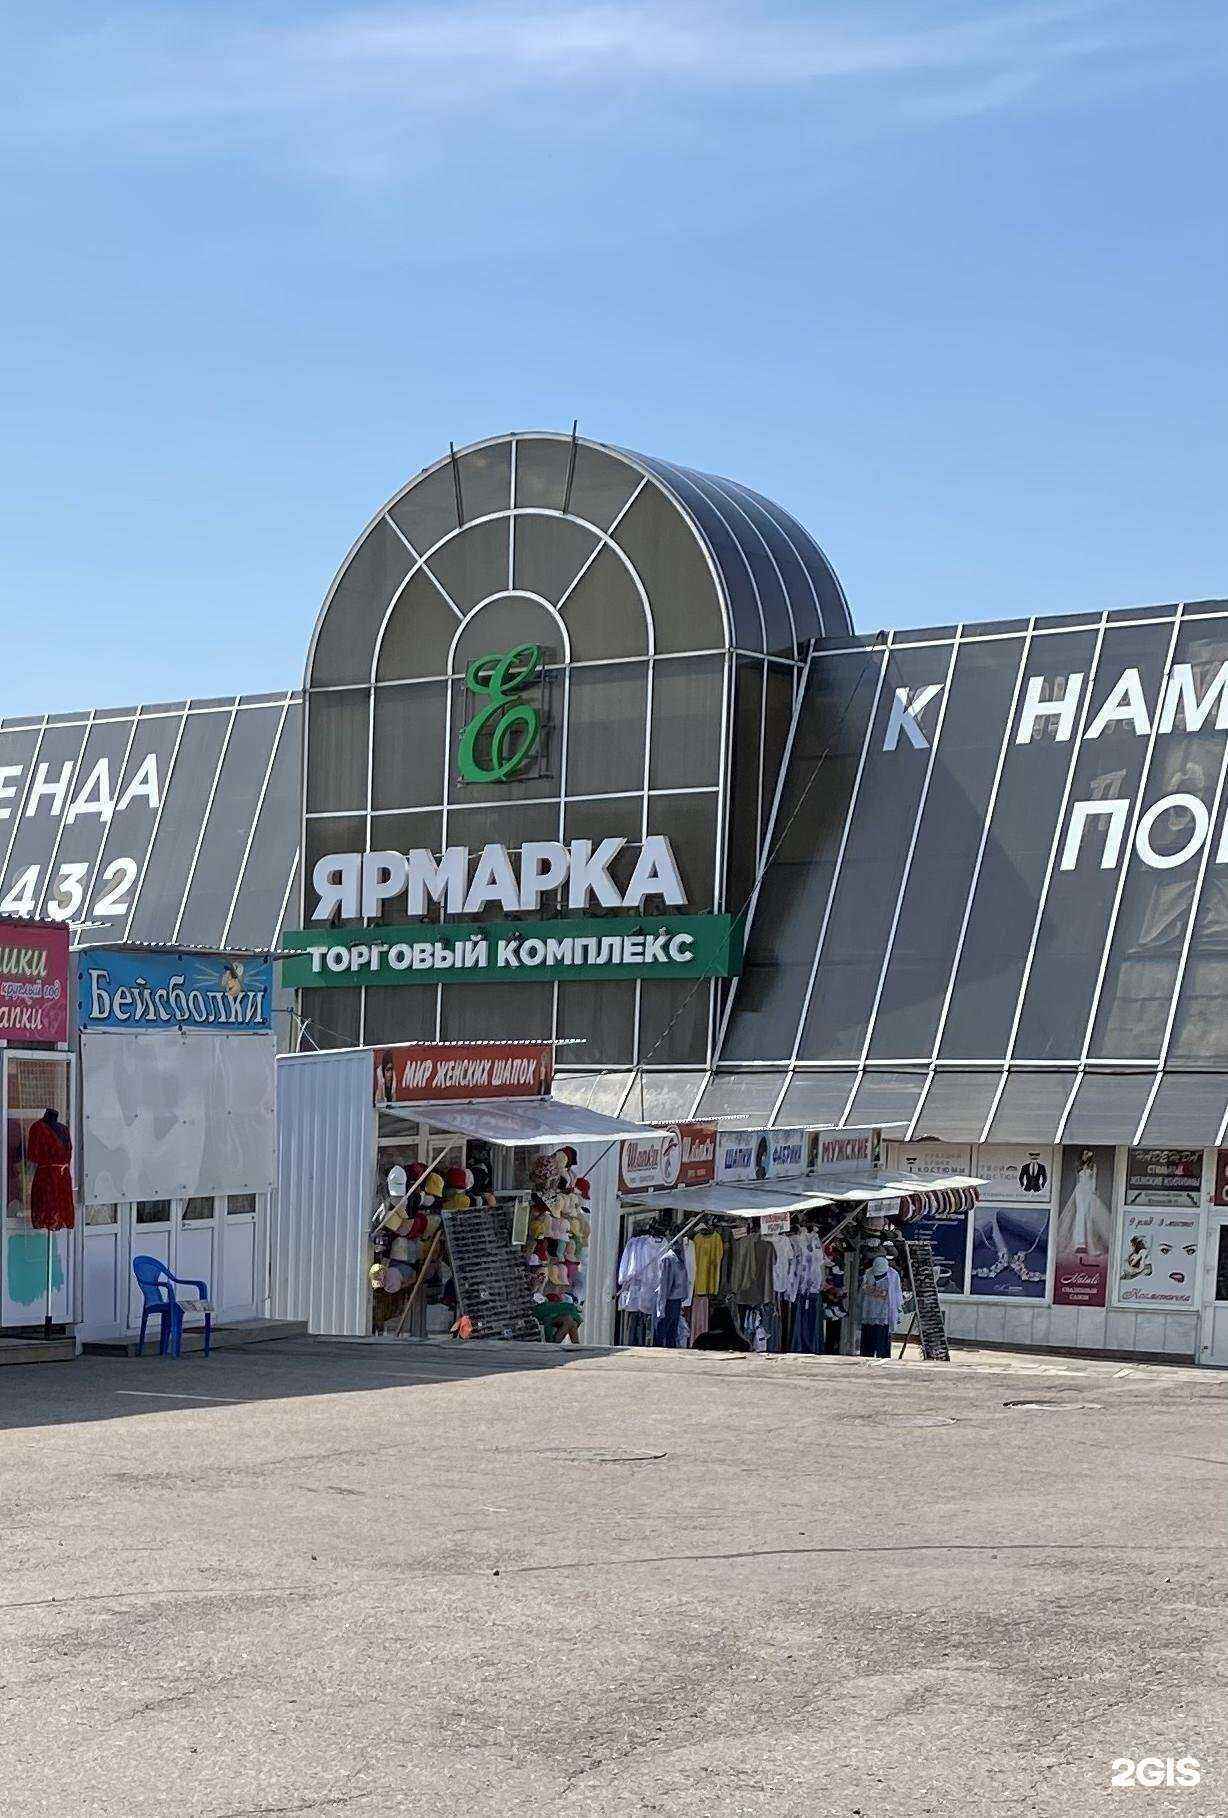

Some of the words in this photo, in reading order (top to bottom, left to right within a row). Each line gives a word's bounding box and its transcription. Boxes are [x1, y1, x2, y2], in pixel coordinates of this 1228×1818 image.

[883, 684, 945, 751] К
[1015, 660, 1228, 745] НАМ
[0, 857, 138, 921] 432
[311, 835, 688, 921] ЯРМАРКА
[0, 947, 47, 977] ики
[307, 933, 488, 972] ТОРГОВЫЙ
[497, 933, 694, 968] КОМПЛЕКС
[89, 968, 264, 1023] Бейсболки
[402, 1060, 432, 1088] МИР
[432, 1059, 491, 1088] ЖЕНСКИХ
[491, 1058, 537, 1085] ШАПОК
